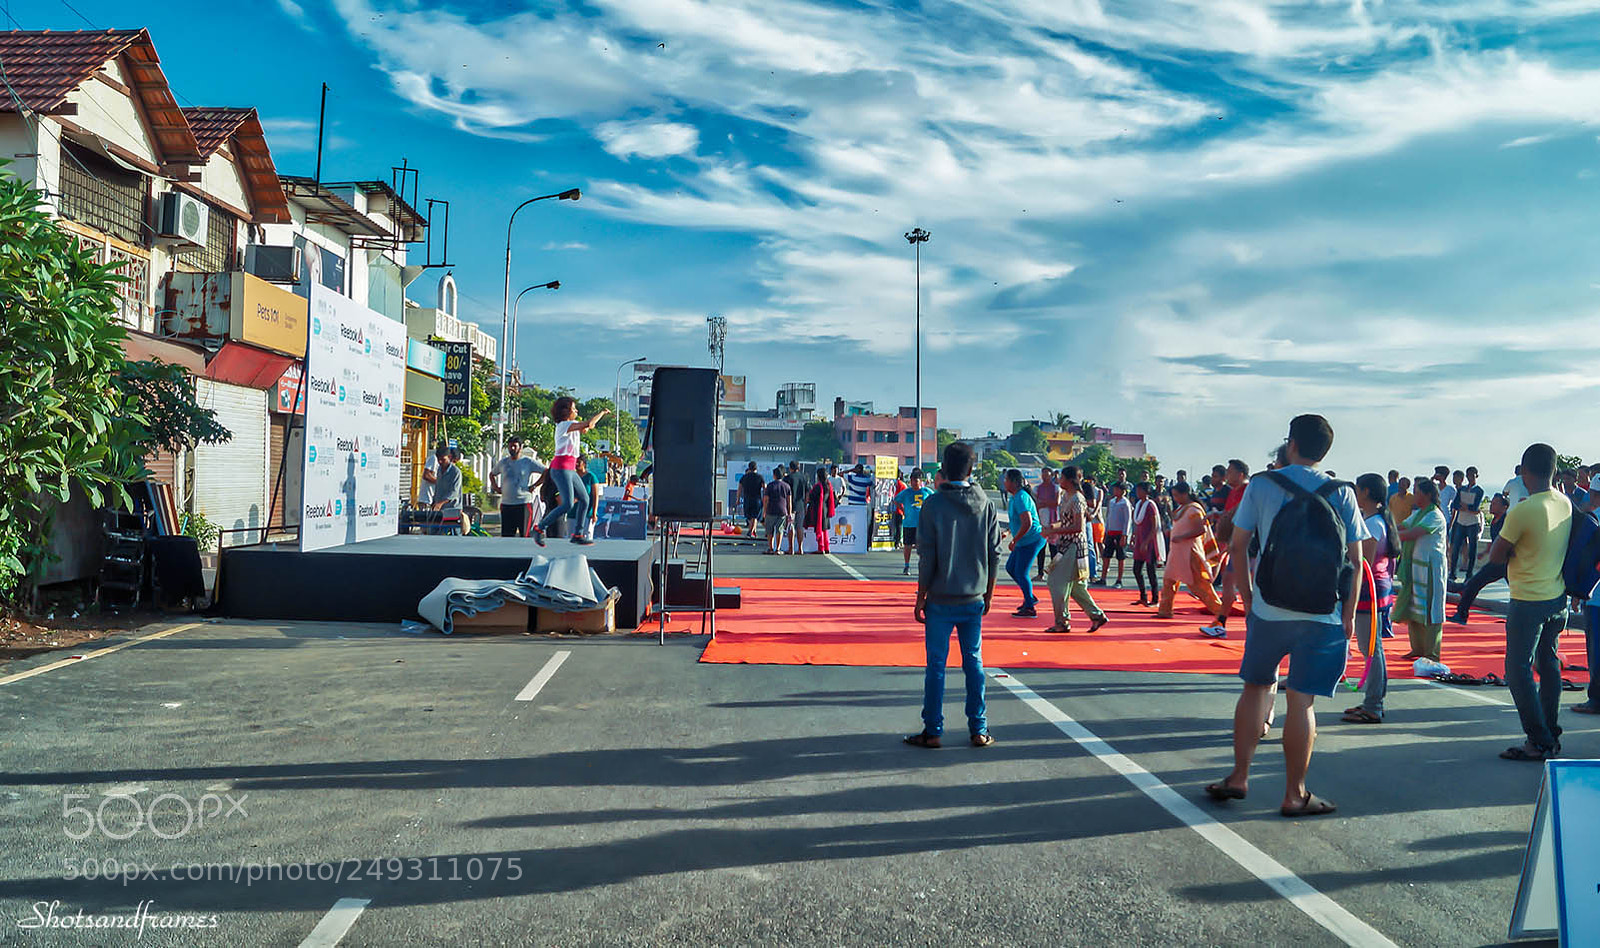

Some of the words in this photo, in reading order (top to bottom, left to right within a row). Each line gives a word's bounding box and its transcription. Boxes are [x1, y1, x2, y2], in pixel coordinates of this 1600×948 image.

[340, 323, 358, 343] Reebok
[385, 341, 400, 358] Reebok
[452, 344, 467, 354] Cut
[445, 372, 463, 380] ave
[310, 375, 331, 394] Reebok
[362, 390, 378, 406] Reebok
[445, 405, 465, 415] LON
[336, 437, 354, 452] Reebok
[381, 444, 395, 457] Reebok
[306, 504, 327, 519] Reebok
[359, 504, 374, 518] Reebok
